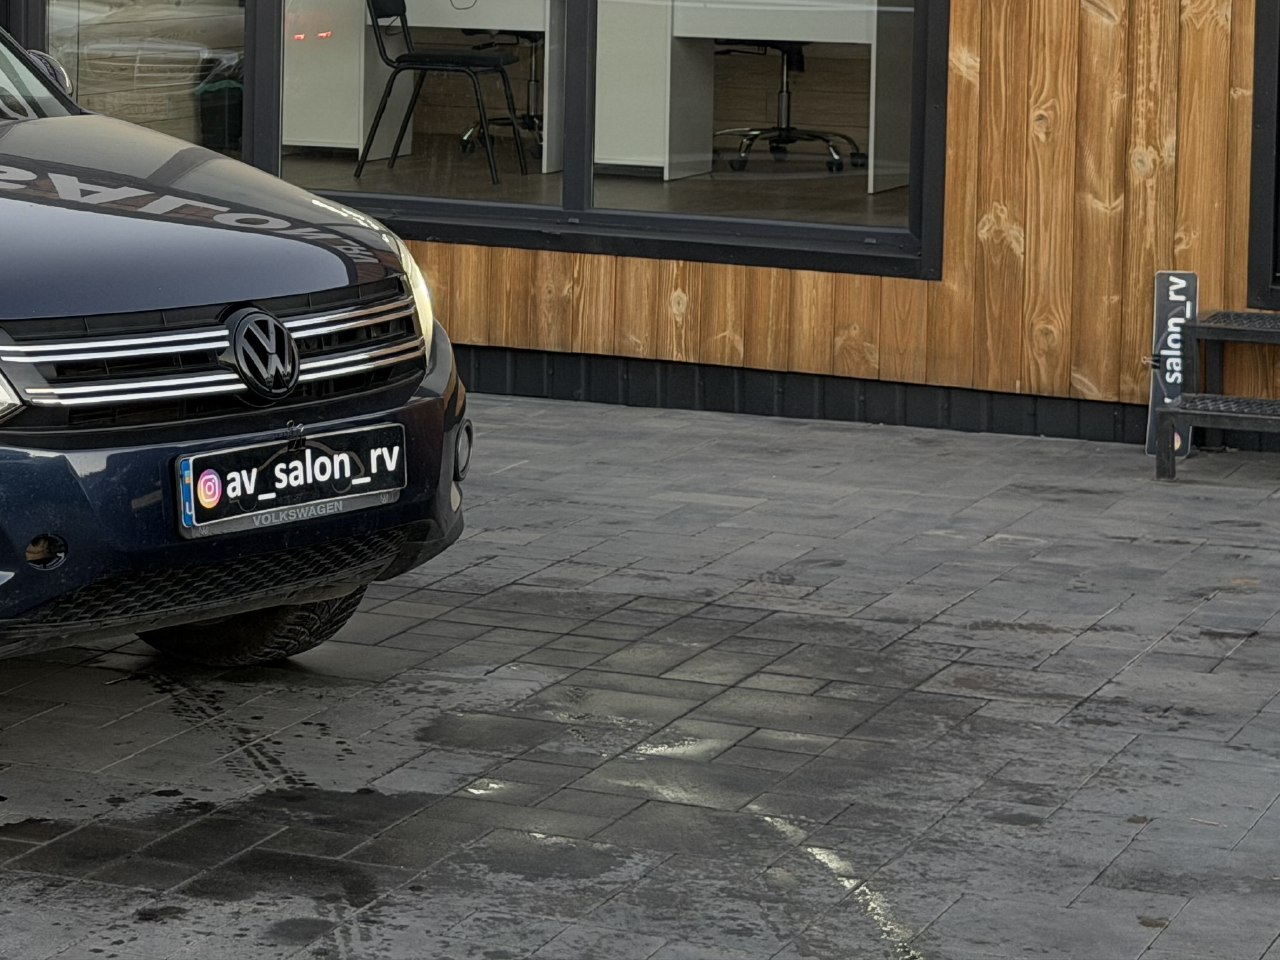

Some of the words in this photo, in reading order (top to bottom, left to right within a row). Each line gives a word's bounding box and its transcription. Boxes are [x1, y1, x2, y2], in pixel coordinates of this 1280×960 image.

[1159, 276, 1193, 405] salon_rv
[226, 445, 400, 501] av_salon_rv
[252, 500, 344, 527] VOLKSWAGEN
